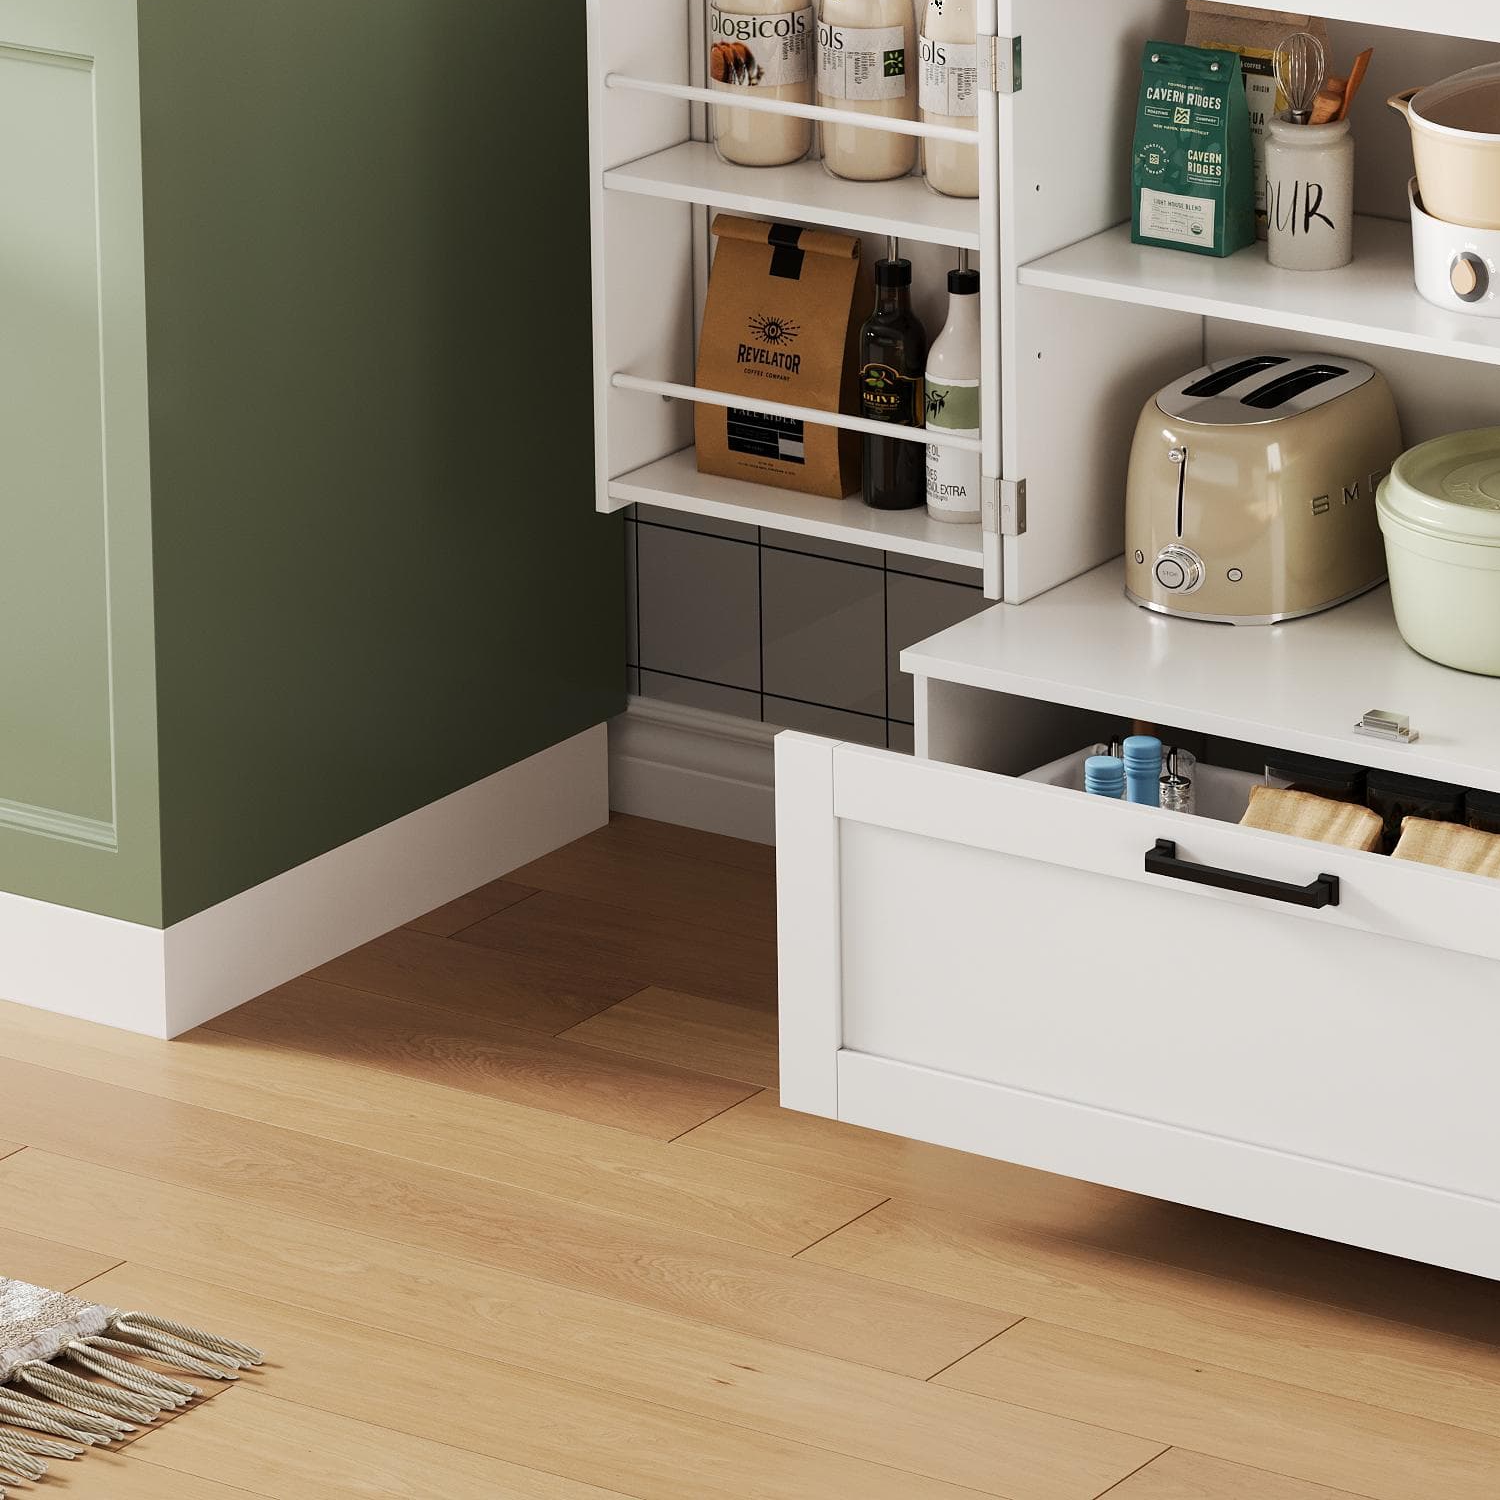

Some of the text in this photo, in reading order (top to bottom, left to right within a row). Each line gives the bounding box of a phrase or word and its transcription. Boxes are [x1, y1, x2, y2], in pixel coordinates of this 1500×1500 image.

[1244, 62, 1262, 70] COFFEE
[1252, 84, 1270, 93] ORIGIN
[1146, 86, 1222, 110] CAVERN RIDGES
[1147, 108, 1168, 116] ROASTING
[1187, 149, 1222, 164] CAVERN
[1187, 161, 1222, 177] RIDGES
[1185, 202, 1202, 212] BLEND
[737, 343, 802, 374] REVELATOR
[744, 368, 790, 382] COFFEE COMPANY
[940, 484, 967, 497] EXTRA
